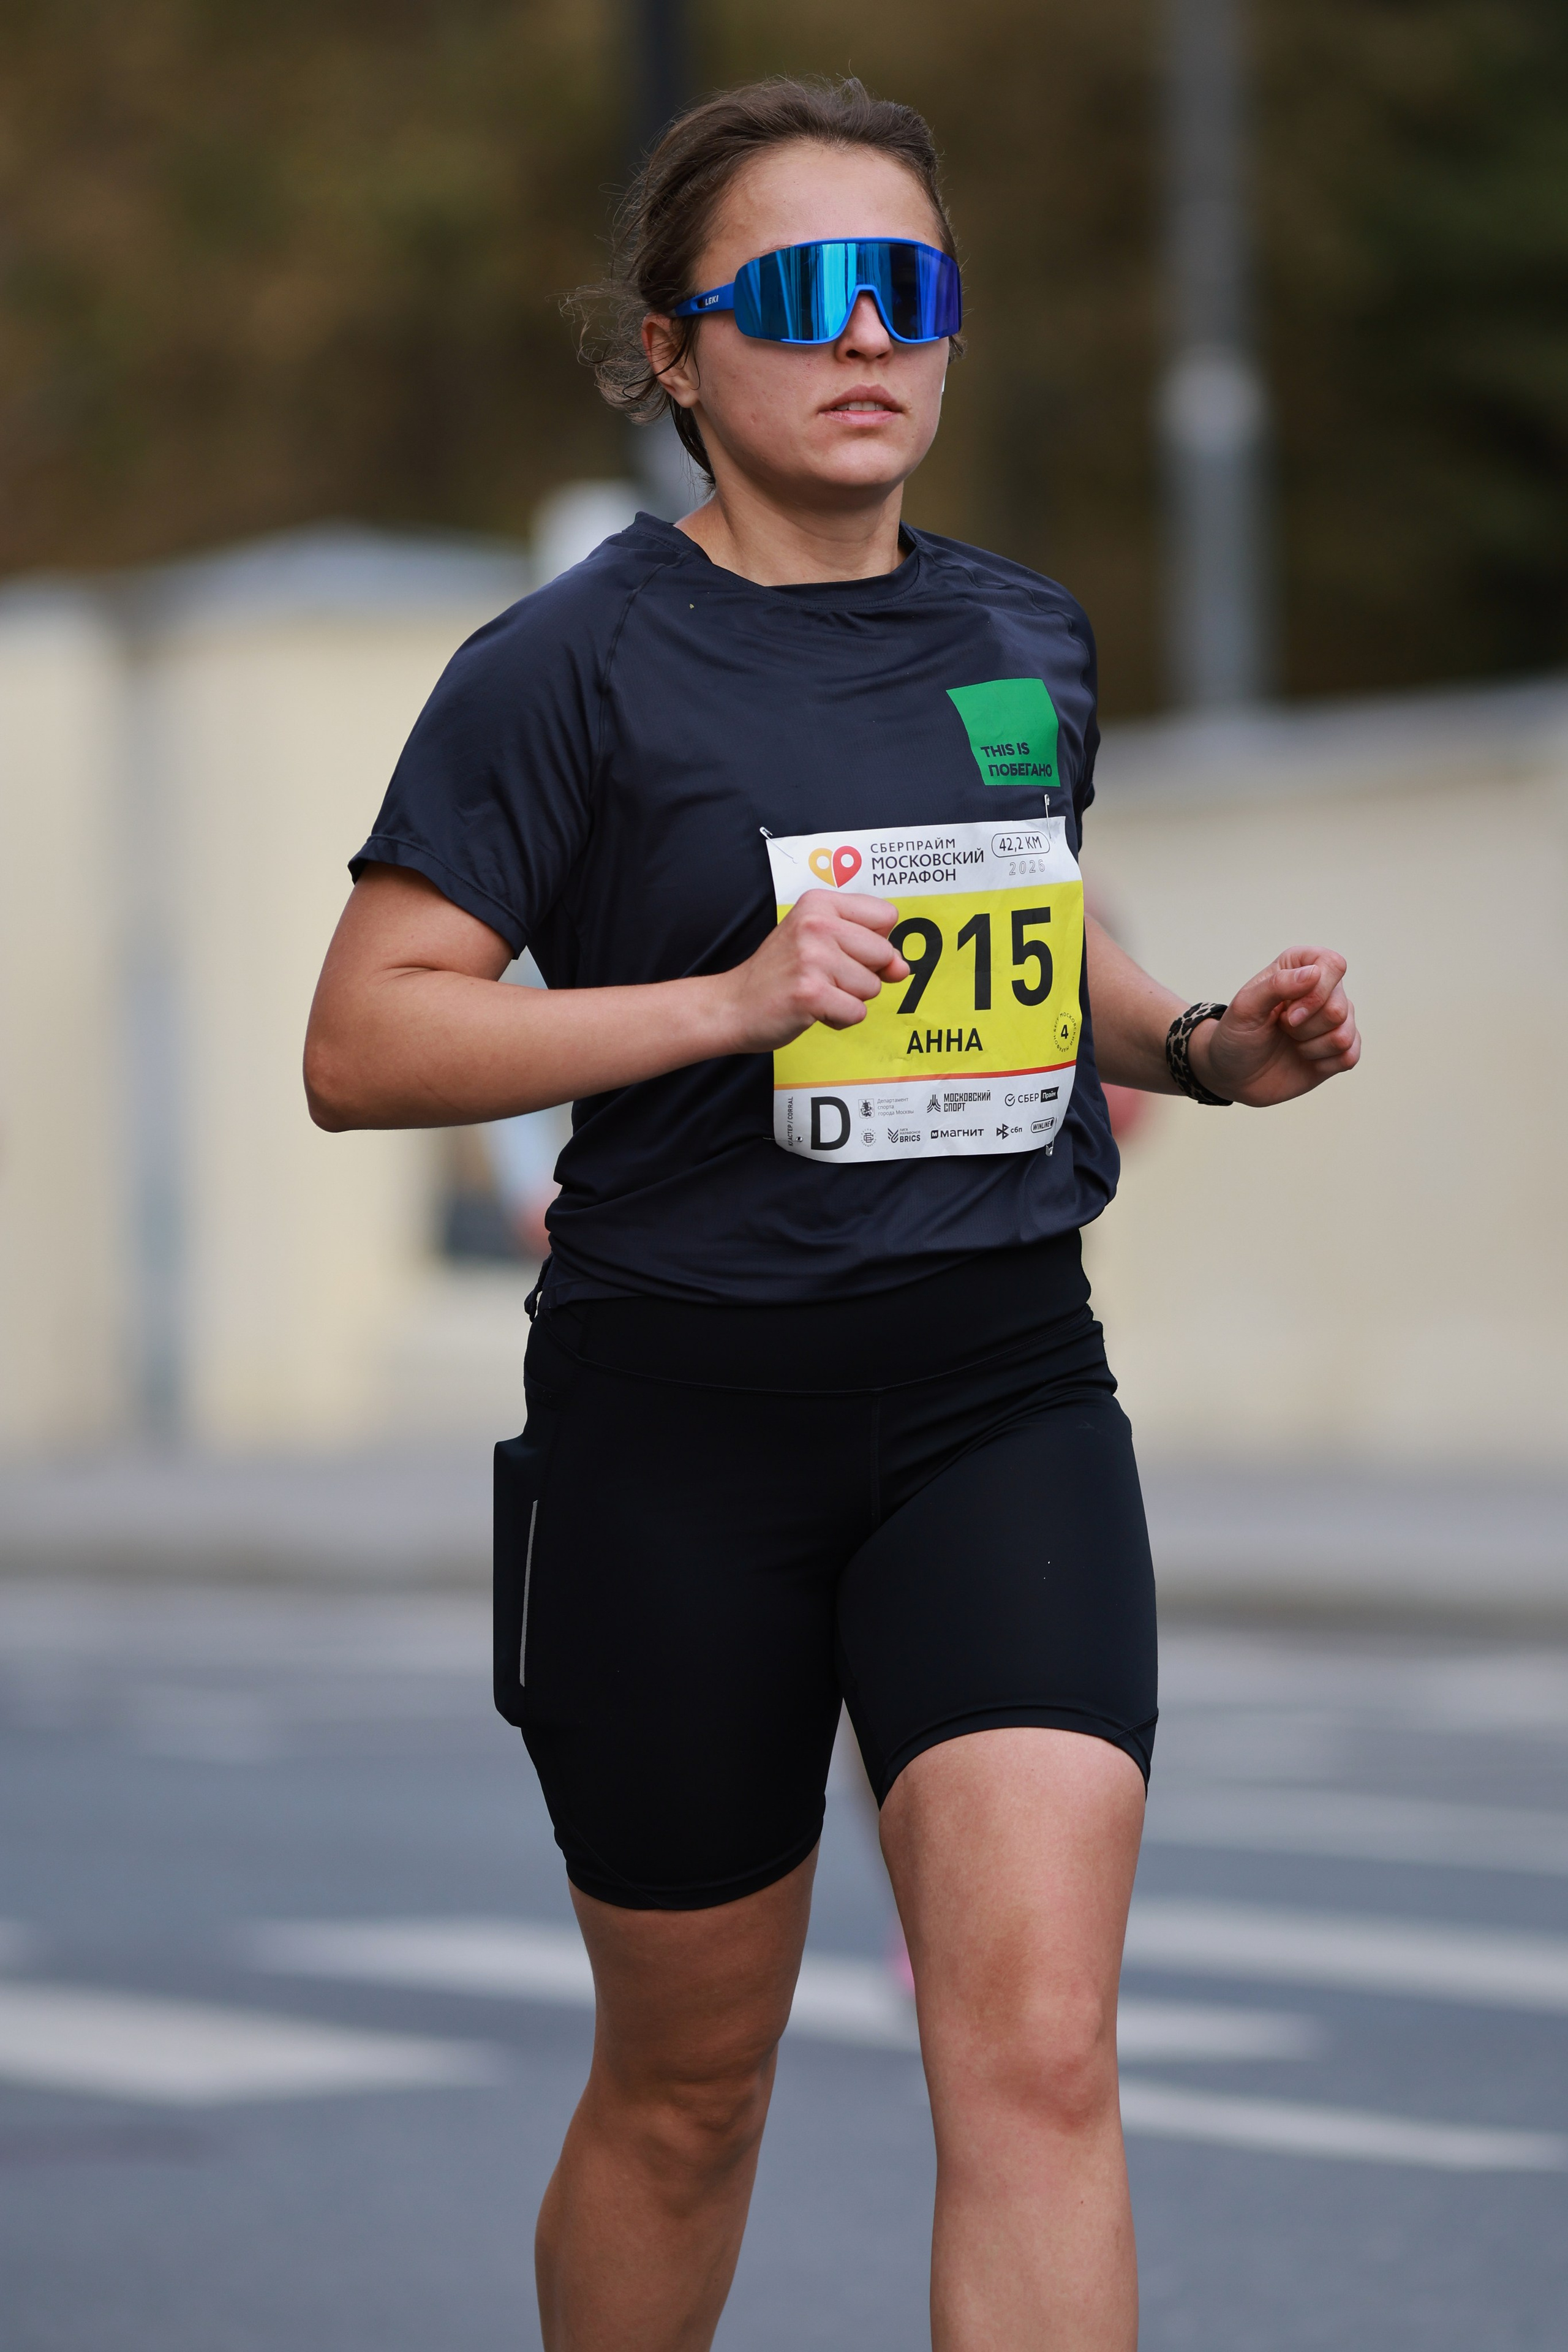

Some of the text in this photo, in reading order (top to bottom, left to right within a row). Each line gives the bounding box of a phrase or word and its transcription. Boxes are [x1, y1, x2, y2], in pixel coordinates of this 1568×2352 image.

[705, 295, 719, 306] LEKI
[980, 742, 1030, 758] THIS IS
[988, 763, 1052, 777] ПОБЕГАНО
[870, 837, 956, 853] СБЕРПРАЙМ
[999, 836, 1042, 852] 42,2 КМ
[872, 848, 984, 870] МОСКОВСКИЙ
[1009, 859, 1046, 876] 2026
[873, 869, 956, 886] МАРАФОН
[1060, 1024, 1069, 1039] 4
[906, 1028, 983, 1055] АННА
[944, 1090, 991, 1102] МОСКОВСКИЙ
[1017, 1090, 1057, 1103] СБЕР Прайм
[944, 1102, 966, 1112] СПОРТ
[811, 1096, 851, 1151] D
[1033, 1120, 1050, 1131] WINLINE
